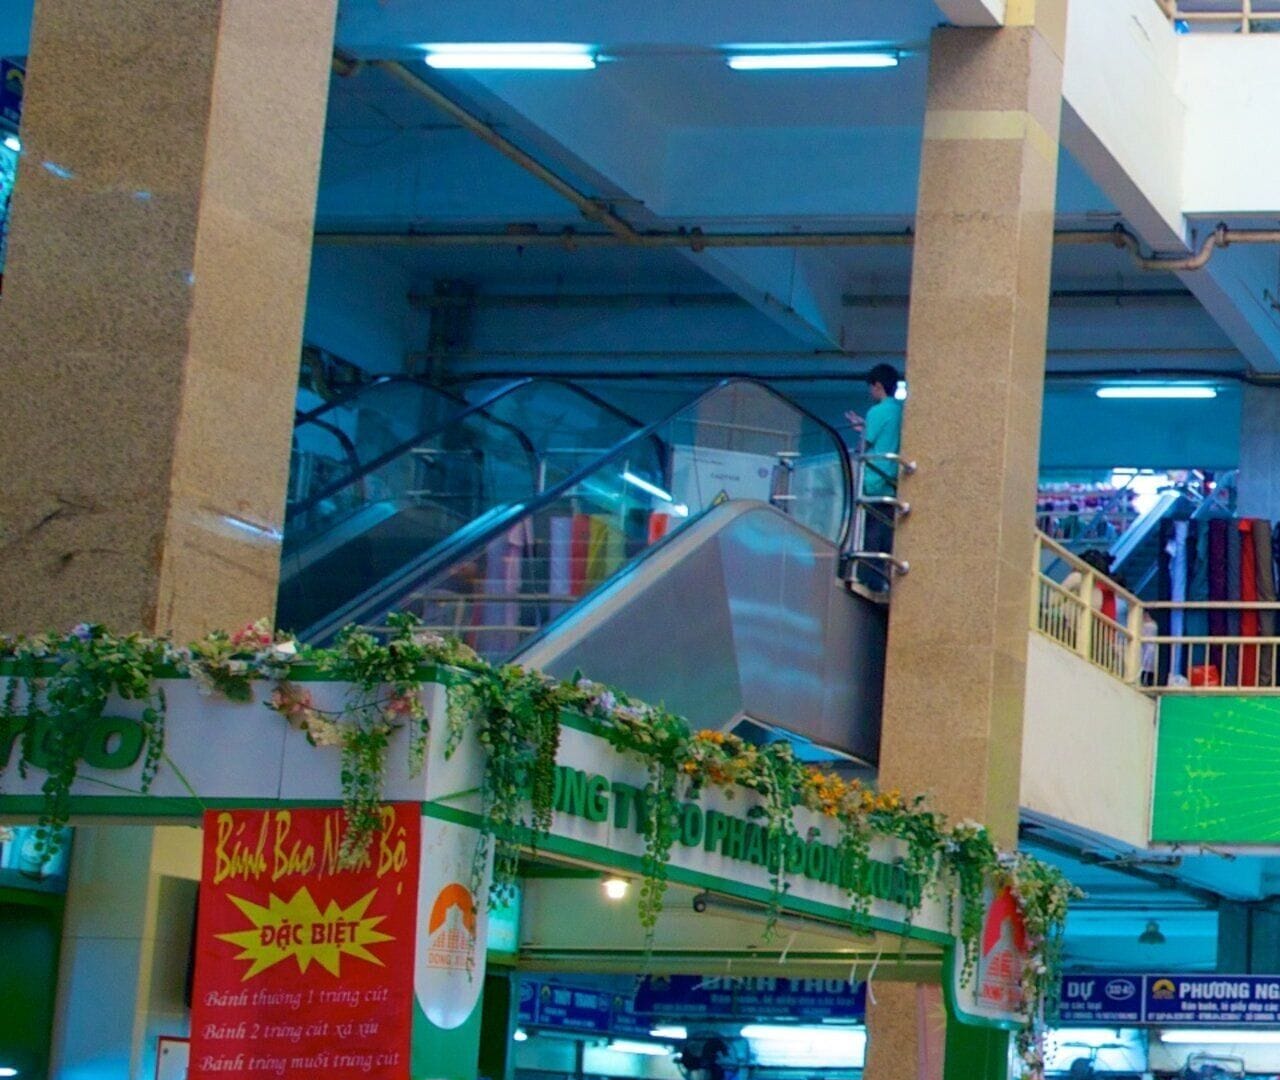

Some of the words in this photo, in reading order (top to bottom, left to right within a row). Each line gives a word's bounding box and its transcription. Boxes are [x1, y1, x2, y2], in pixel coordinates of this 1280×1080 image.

[213, 810, 270, 885] Bánh
[272, 809, 315, 882] Bao
[260, 919, 304, 951] ĐẶC
[310, 917, 360, 949] BIỆT
[250, 1023, 260, 1040] 2
